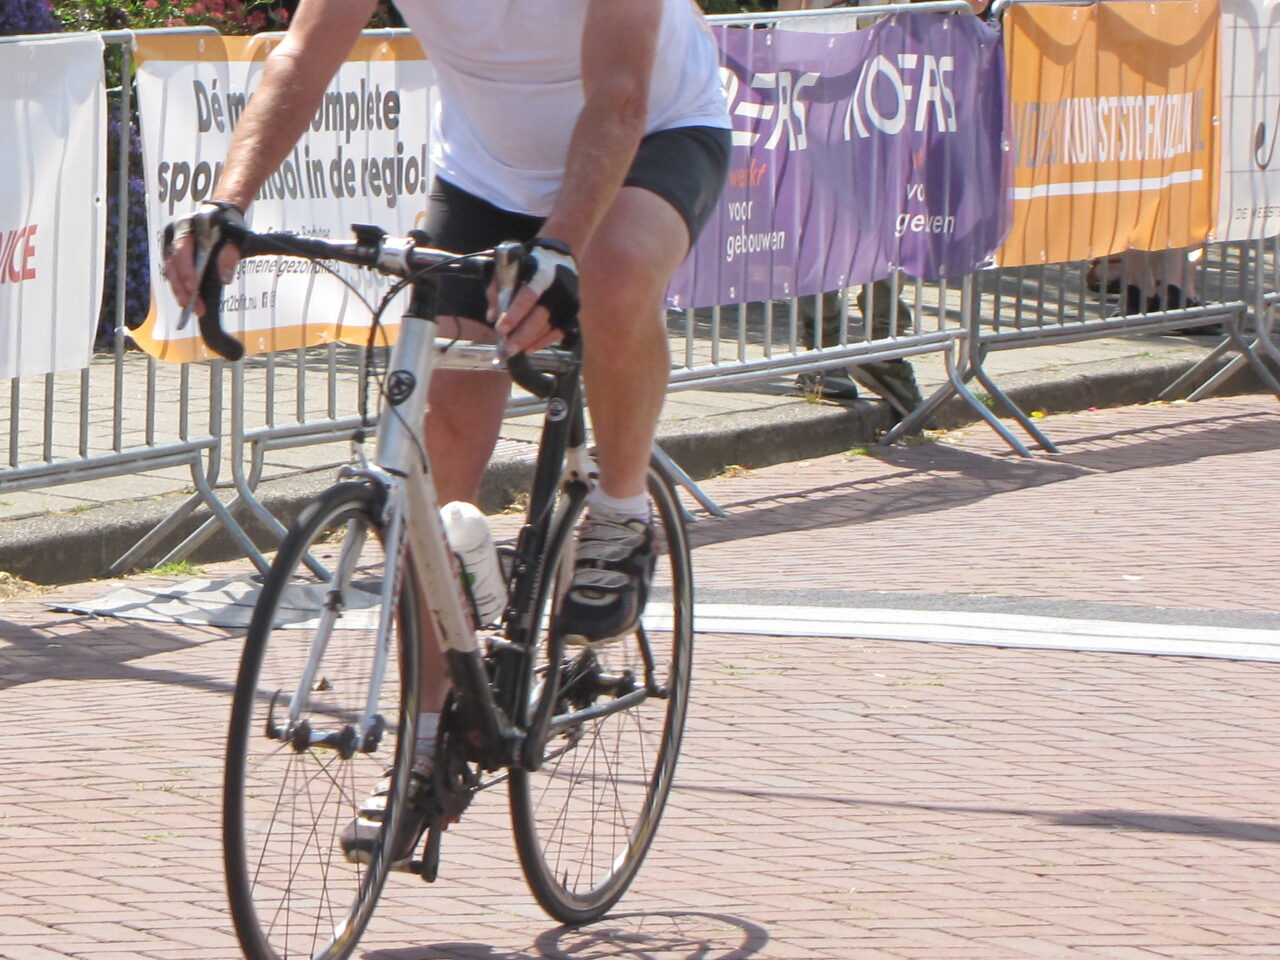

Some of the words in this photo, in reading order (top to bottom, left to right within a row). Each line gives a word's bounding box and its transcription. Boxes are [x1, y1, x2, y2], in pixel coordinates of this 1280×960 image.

[193, 78, 225, 133] Dé
[304, 77, 401, 144] omplete
[304, 144, 326, 204] in
[329, 145, 356, 199] de
[361, 141, 426, 208] regio!
[728, 200, 753, 221] voor
[726, 225, 785, 262] gebouwen
